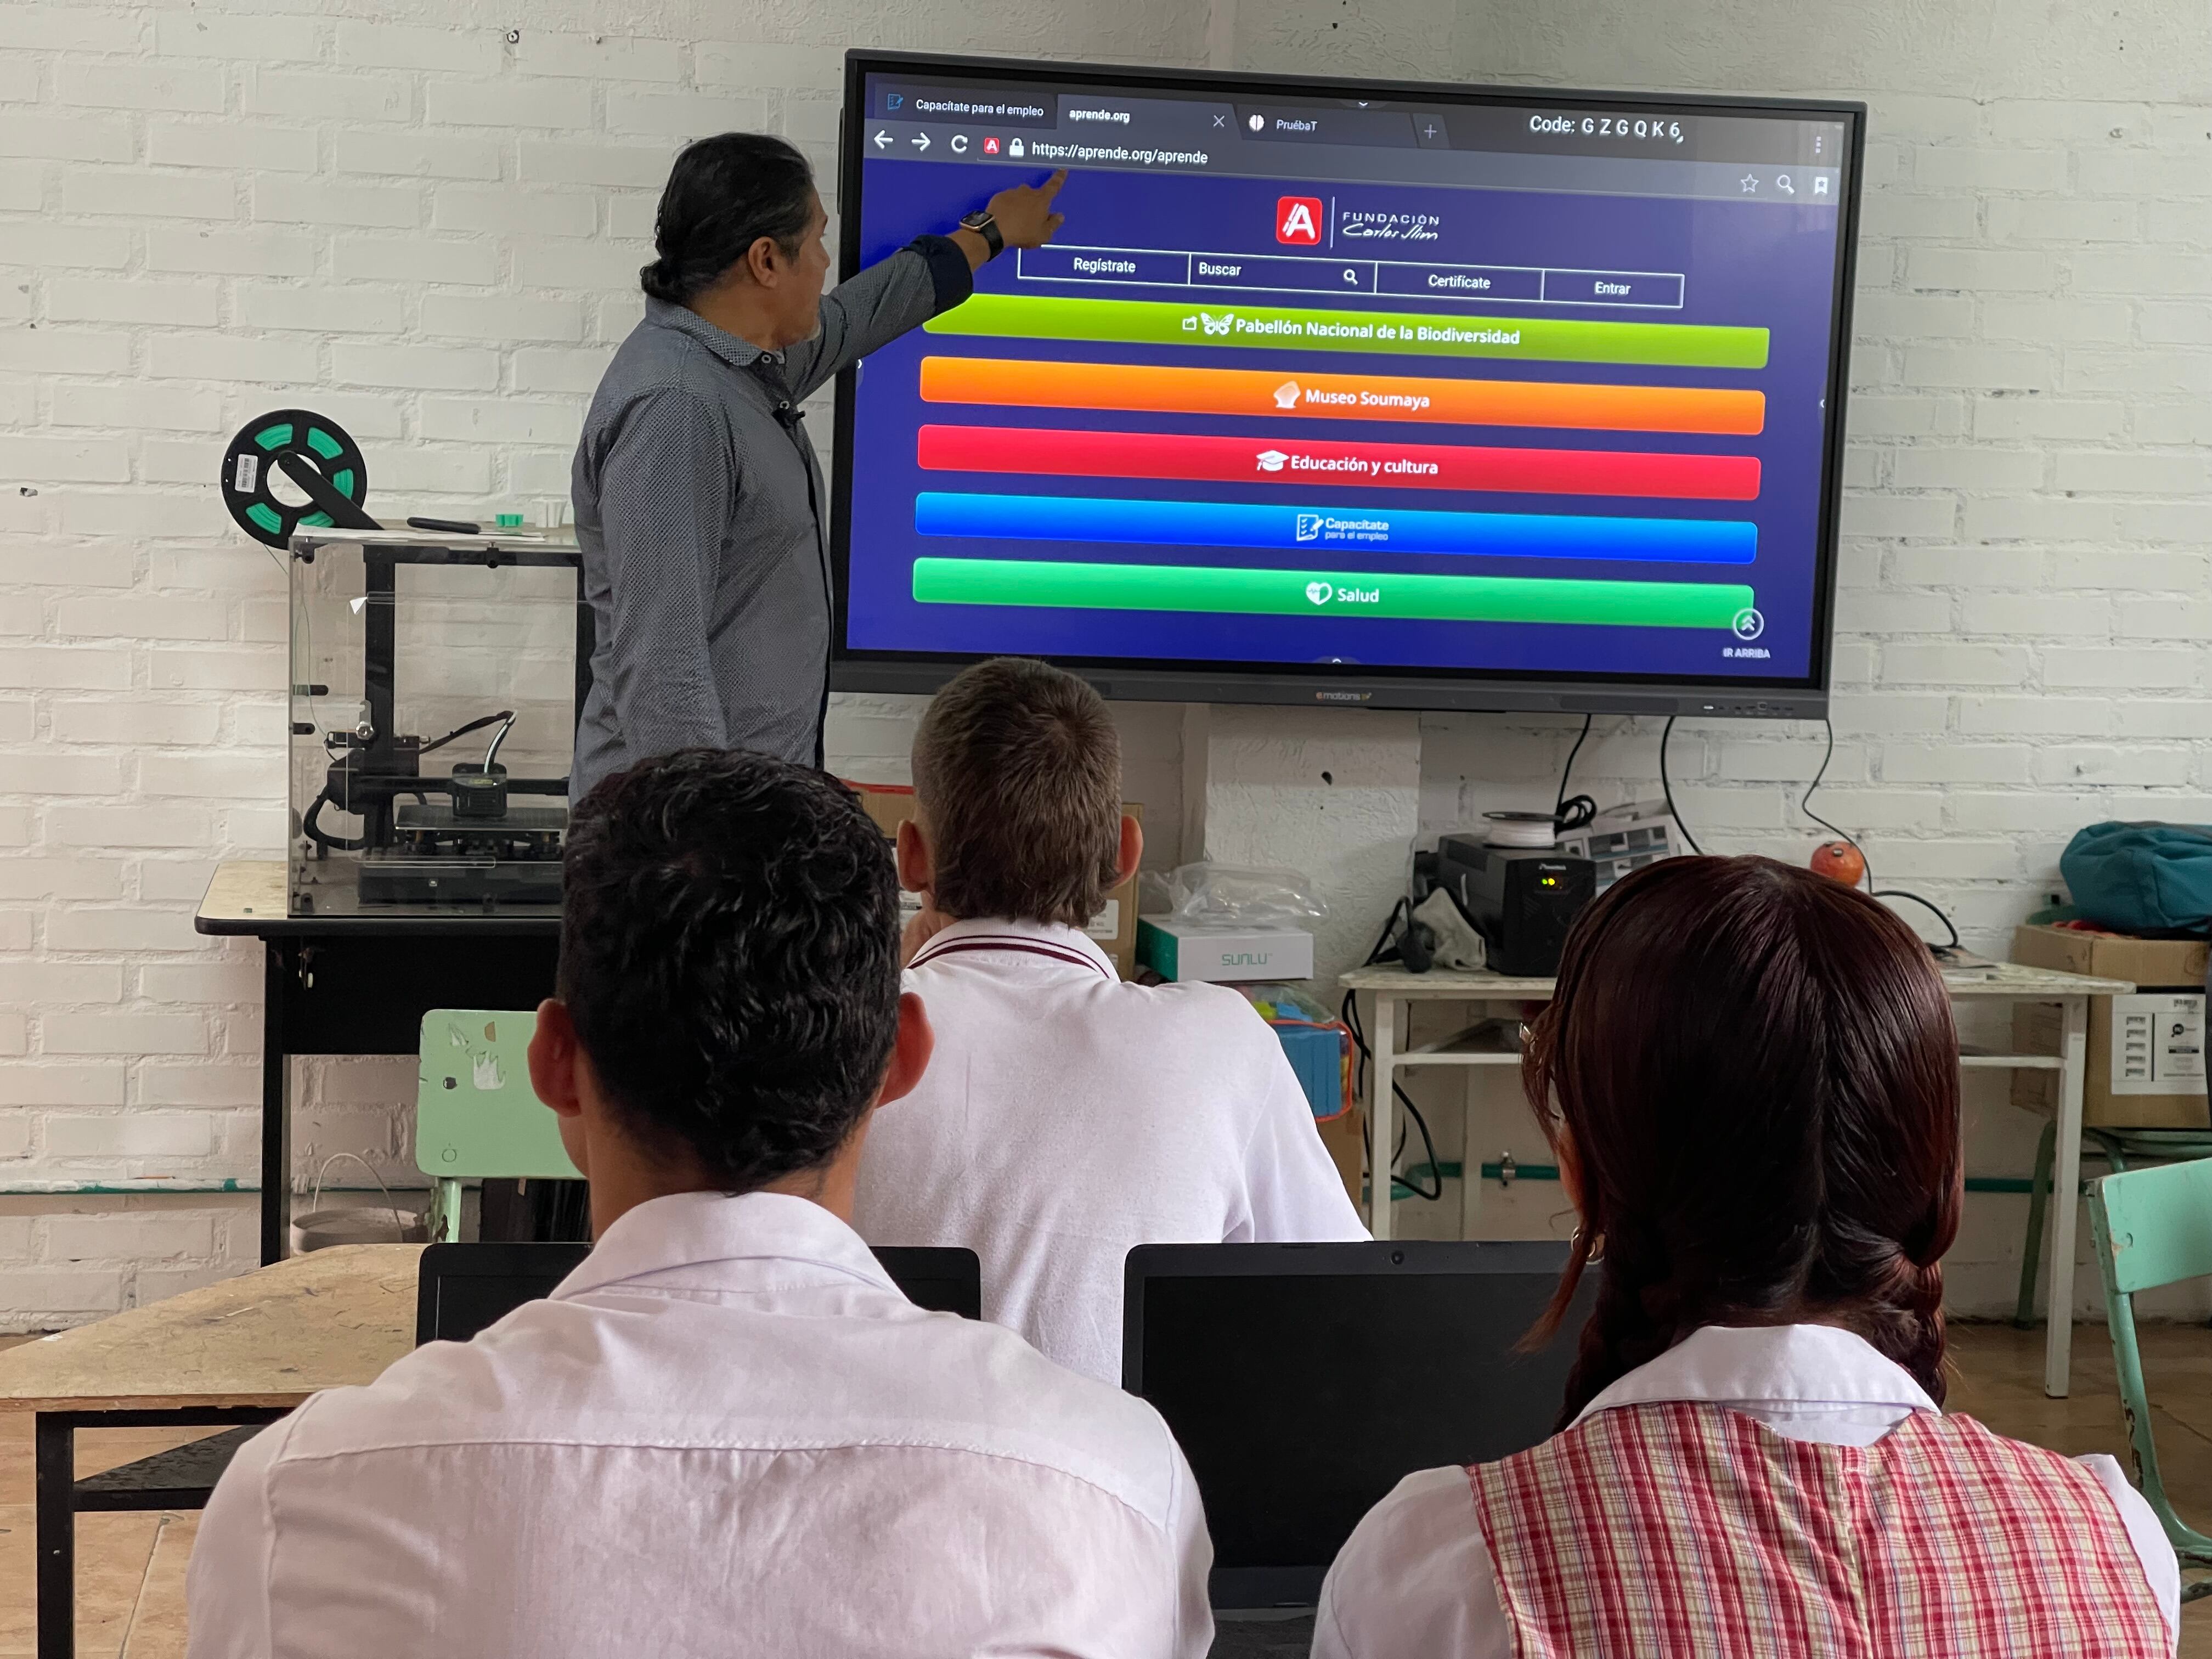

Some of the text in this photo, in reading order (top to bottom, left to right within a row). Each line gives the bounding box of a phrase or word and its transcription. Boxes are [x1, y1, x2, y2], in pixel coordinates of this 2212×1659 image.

[916, 99, 1044, 117] Capacítate para el empleo
[1069, 108, 1131, 123] aprende.org
[1276, 119, 1318, 132] PruébaT
[1530, 115, 1576, 133] Code:
[1581, 117, 1595, 134] G
[1600, 119, 1612, 135] Z
[1616, 119, 1629, 136] G
[1634, 120, 1647, 138] Q
[1652, 120, 1664, 137] K
[1032, 141, 1208, 165] https://aprende.org/aprende
[1342, 211, 1440, 226] FUNDACIÓN
[1342, 223, 1399, 239] Carlos
[1074, 257, 1137, 274] Regístrate
[1198, 261, 1242, 276] Buscar
[1429, 273, 1491, 289] Certifícate
[1594, 280, 1632, 296] Entrar
[1236, 318, 1521, 345] Pabellón Nacional de la Biodiversidad
[1305, 389, 1430, 411] Museo Soumaya
[1291, 454, 1439, 476] Educación y cultura
[1325, 517, 1389, 531] Capacítate
[1325, 531, 1389, 541] para el empleo
[1337, 588, 1380, 602] Salud
[1723, 647, 1771, 658] IR ARRIBA
